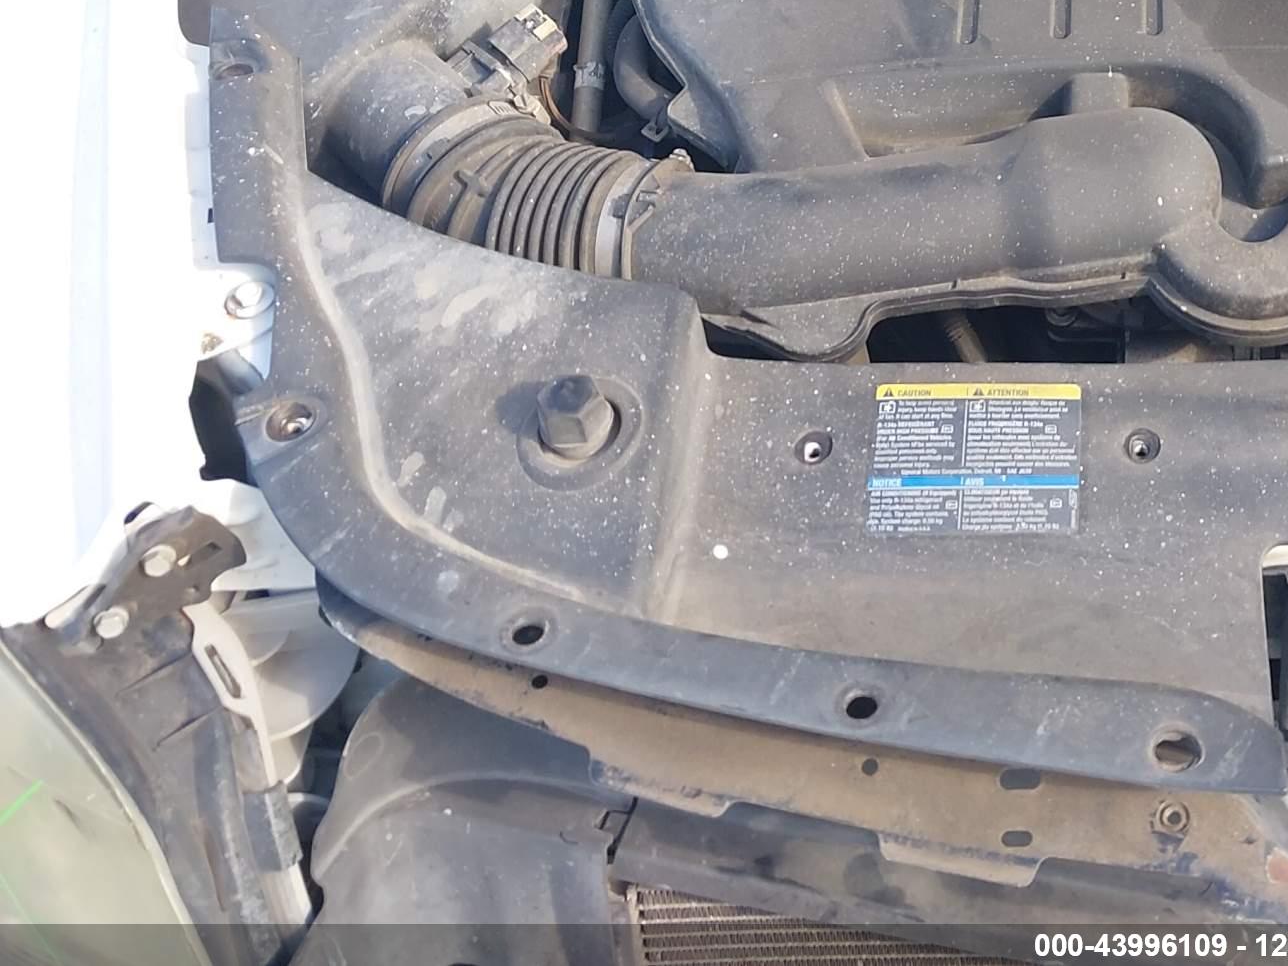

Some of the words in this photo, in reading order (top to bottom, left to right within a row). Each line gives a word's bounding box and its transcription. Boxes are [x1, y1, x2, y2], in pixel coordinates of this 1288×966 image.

[897, 389, 931, 397] CAUTION
[873, 478, 902, 487] NOTICE
[965, 477, 984, 486] AVIS
